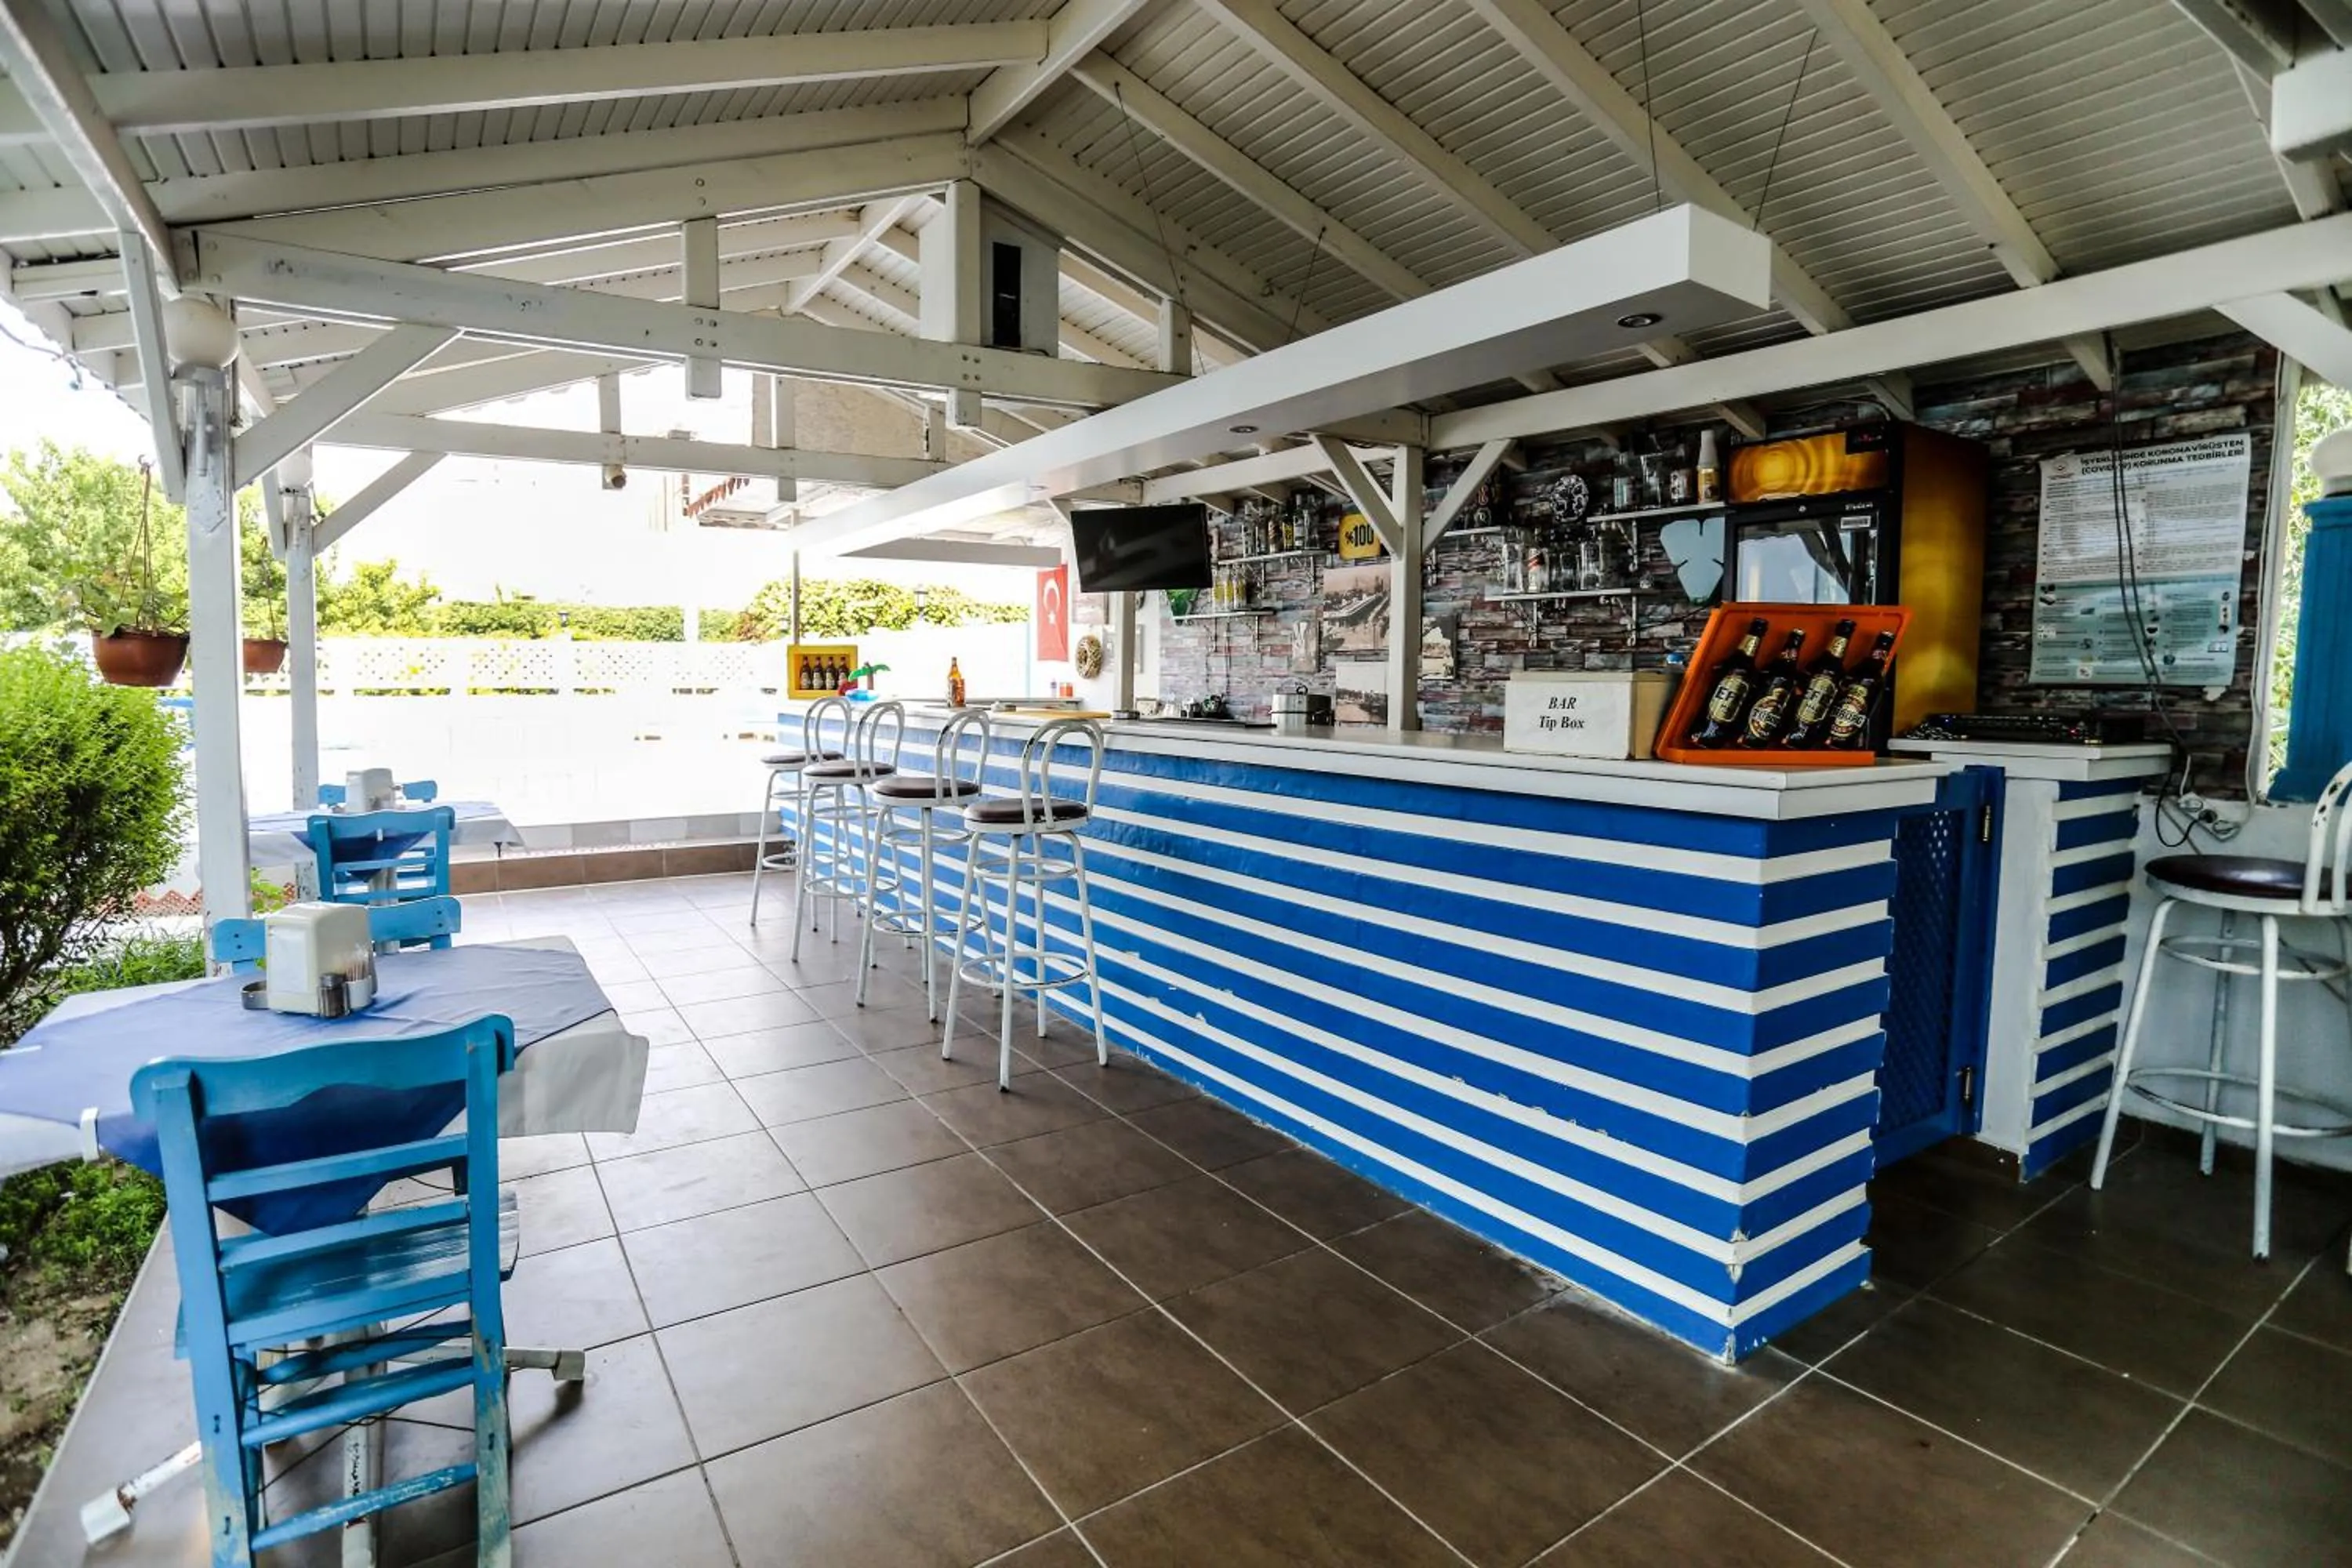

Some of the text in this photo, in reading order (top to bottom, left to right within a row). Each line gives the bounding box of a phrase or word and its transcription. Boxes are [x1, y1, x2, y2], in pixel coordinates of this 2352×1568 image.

[1548, 697, 1577, 709] BAR
[1539, 715, 1585, 731] Tip Box
